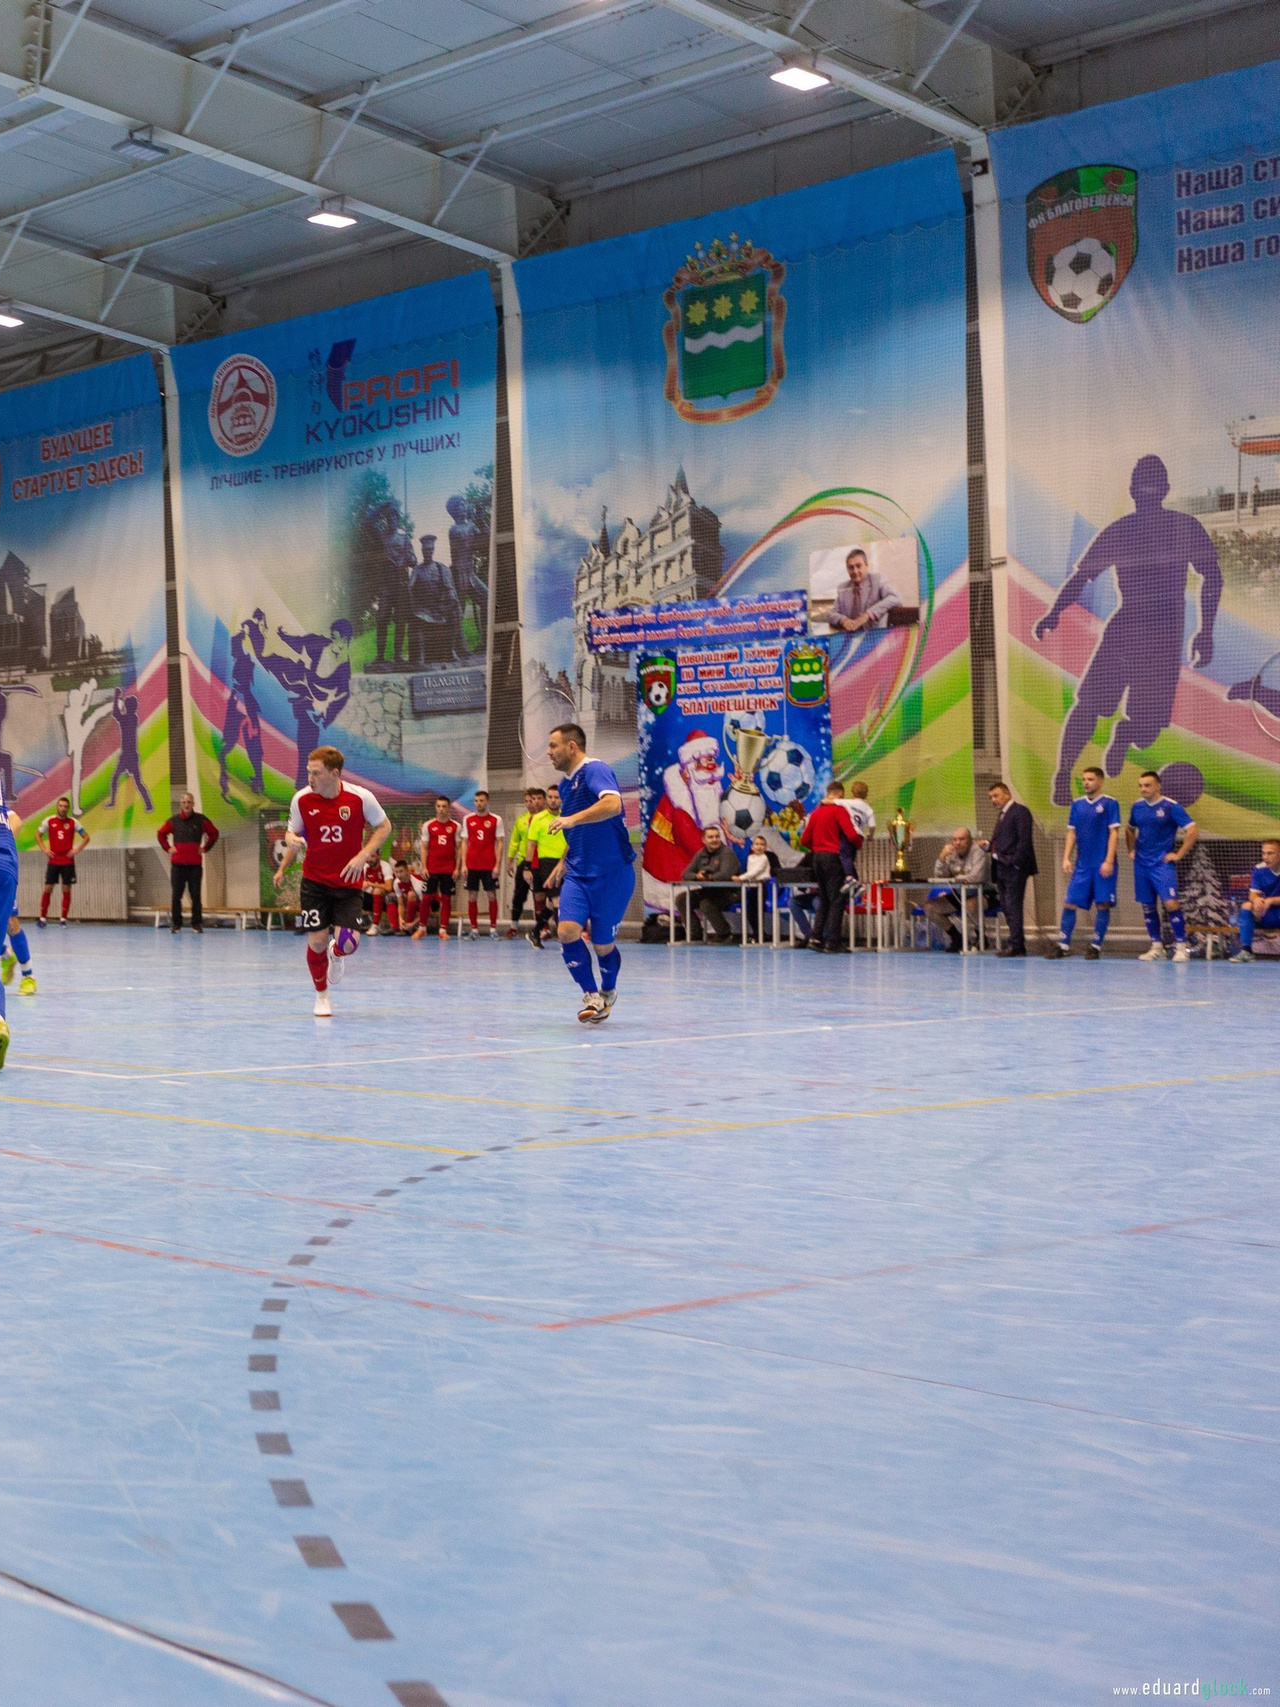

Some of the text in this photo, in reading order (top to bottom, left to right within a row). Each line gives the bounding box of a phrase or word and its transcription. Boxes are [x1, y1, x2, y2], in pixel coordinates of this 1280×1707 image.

[1176, 164, 1244, 198] Наша
[1047, 194, 1135, 221] БЛАГОВЕЩЕНСК
[1176, 203, 1245, 236] Наша
[1177, 241, 1245, 274] Наша
[343, 358, 460, 411] PROFI
[305, 393, 461, 446] KYOKUSHIN
[41, 422, 113, 462] БУДУЩЕЕ
[12, 450, 144, 501] СТАРТУЕТ ЗДЕСЬ!
[209, 469, 263, 491] ЛУЧШИЕ
[272, 449, 374, 481] ТРЕНИРУЮТСЯ
[374, 446, 387, 463] У
[391, 432, 461, 460] ЛУЧШИХ!
[681, 667, 695, 681] ПО
[320, 825, 343, 843] 23
[476, 829, 484, 841] 3
[302, 909, 320, 927] 23
